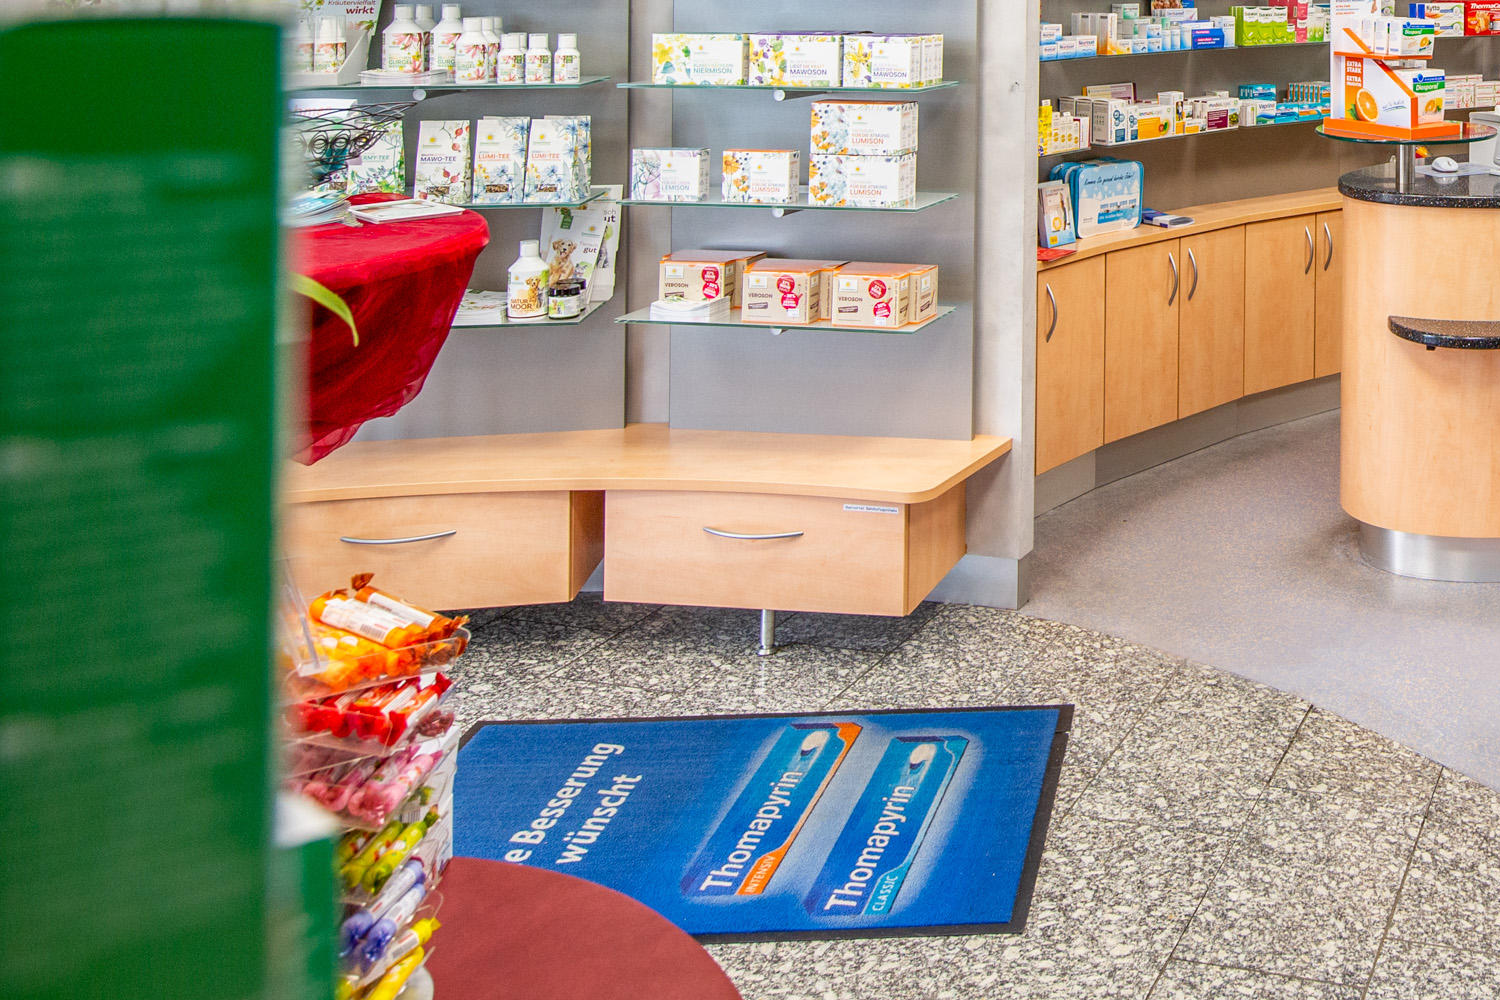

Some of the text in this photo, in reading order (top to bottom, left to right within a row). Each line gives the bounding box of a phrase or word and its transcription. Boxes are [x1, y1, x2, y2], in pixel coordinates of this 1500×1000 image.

[346, 6, 375, 14] wirkt
[790, 68, 827, 76] MAWOSON
[873, 70, 907, 78] MAWOSON
[851, 137, 884, 145] LUMISON
[516, 741, 625, 848] Besserung
[555, 773, 643, 865] wünscht
[701, 769, 804, 892] Thomapyrin
[825, 785, 915, 913] Thomapyrin
[744, 855, 776, 895] INTENSIV
[871, 873, 899, 912] CLASSIC
